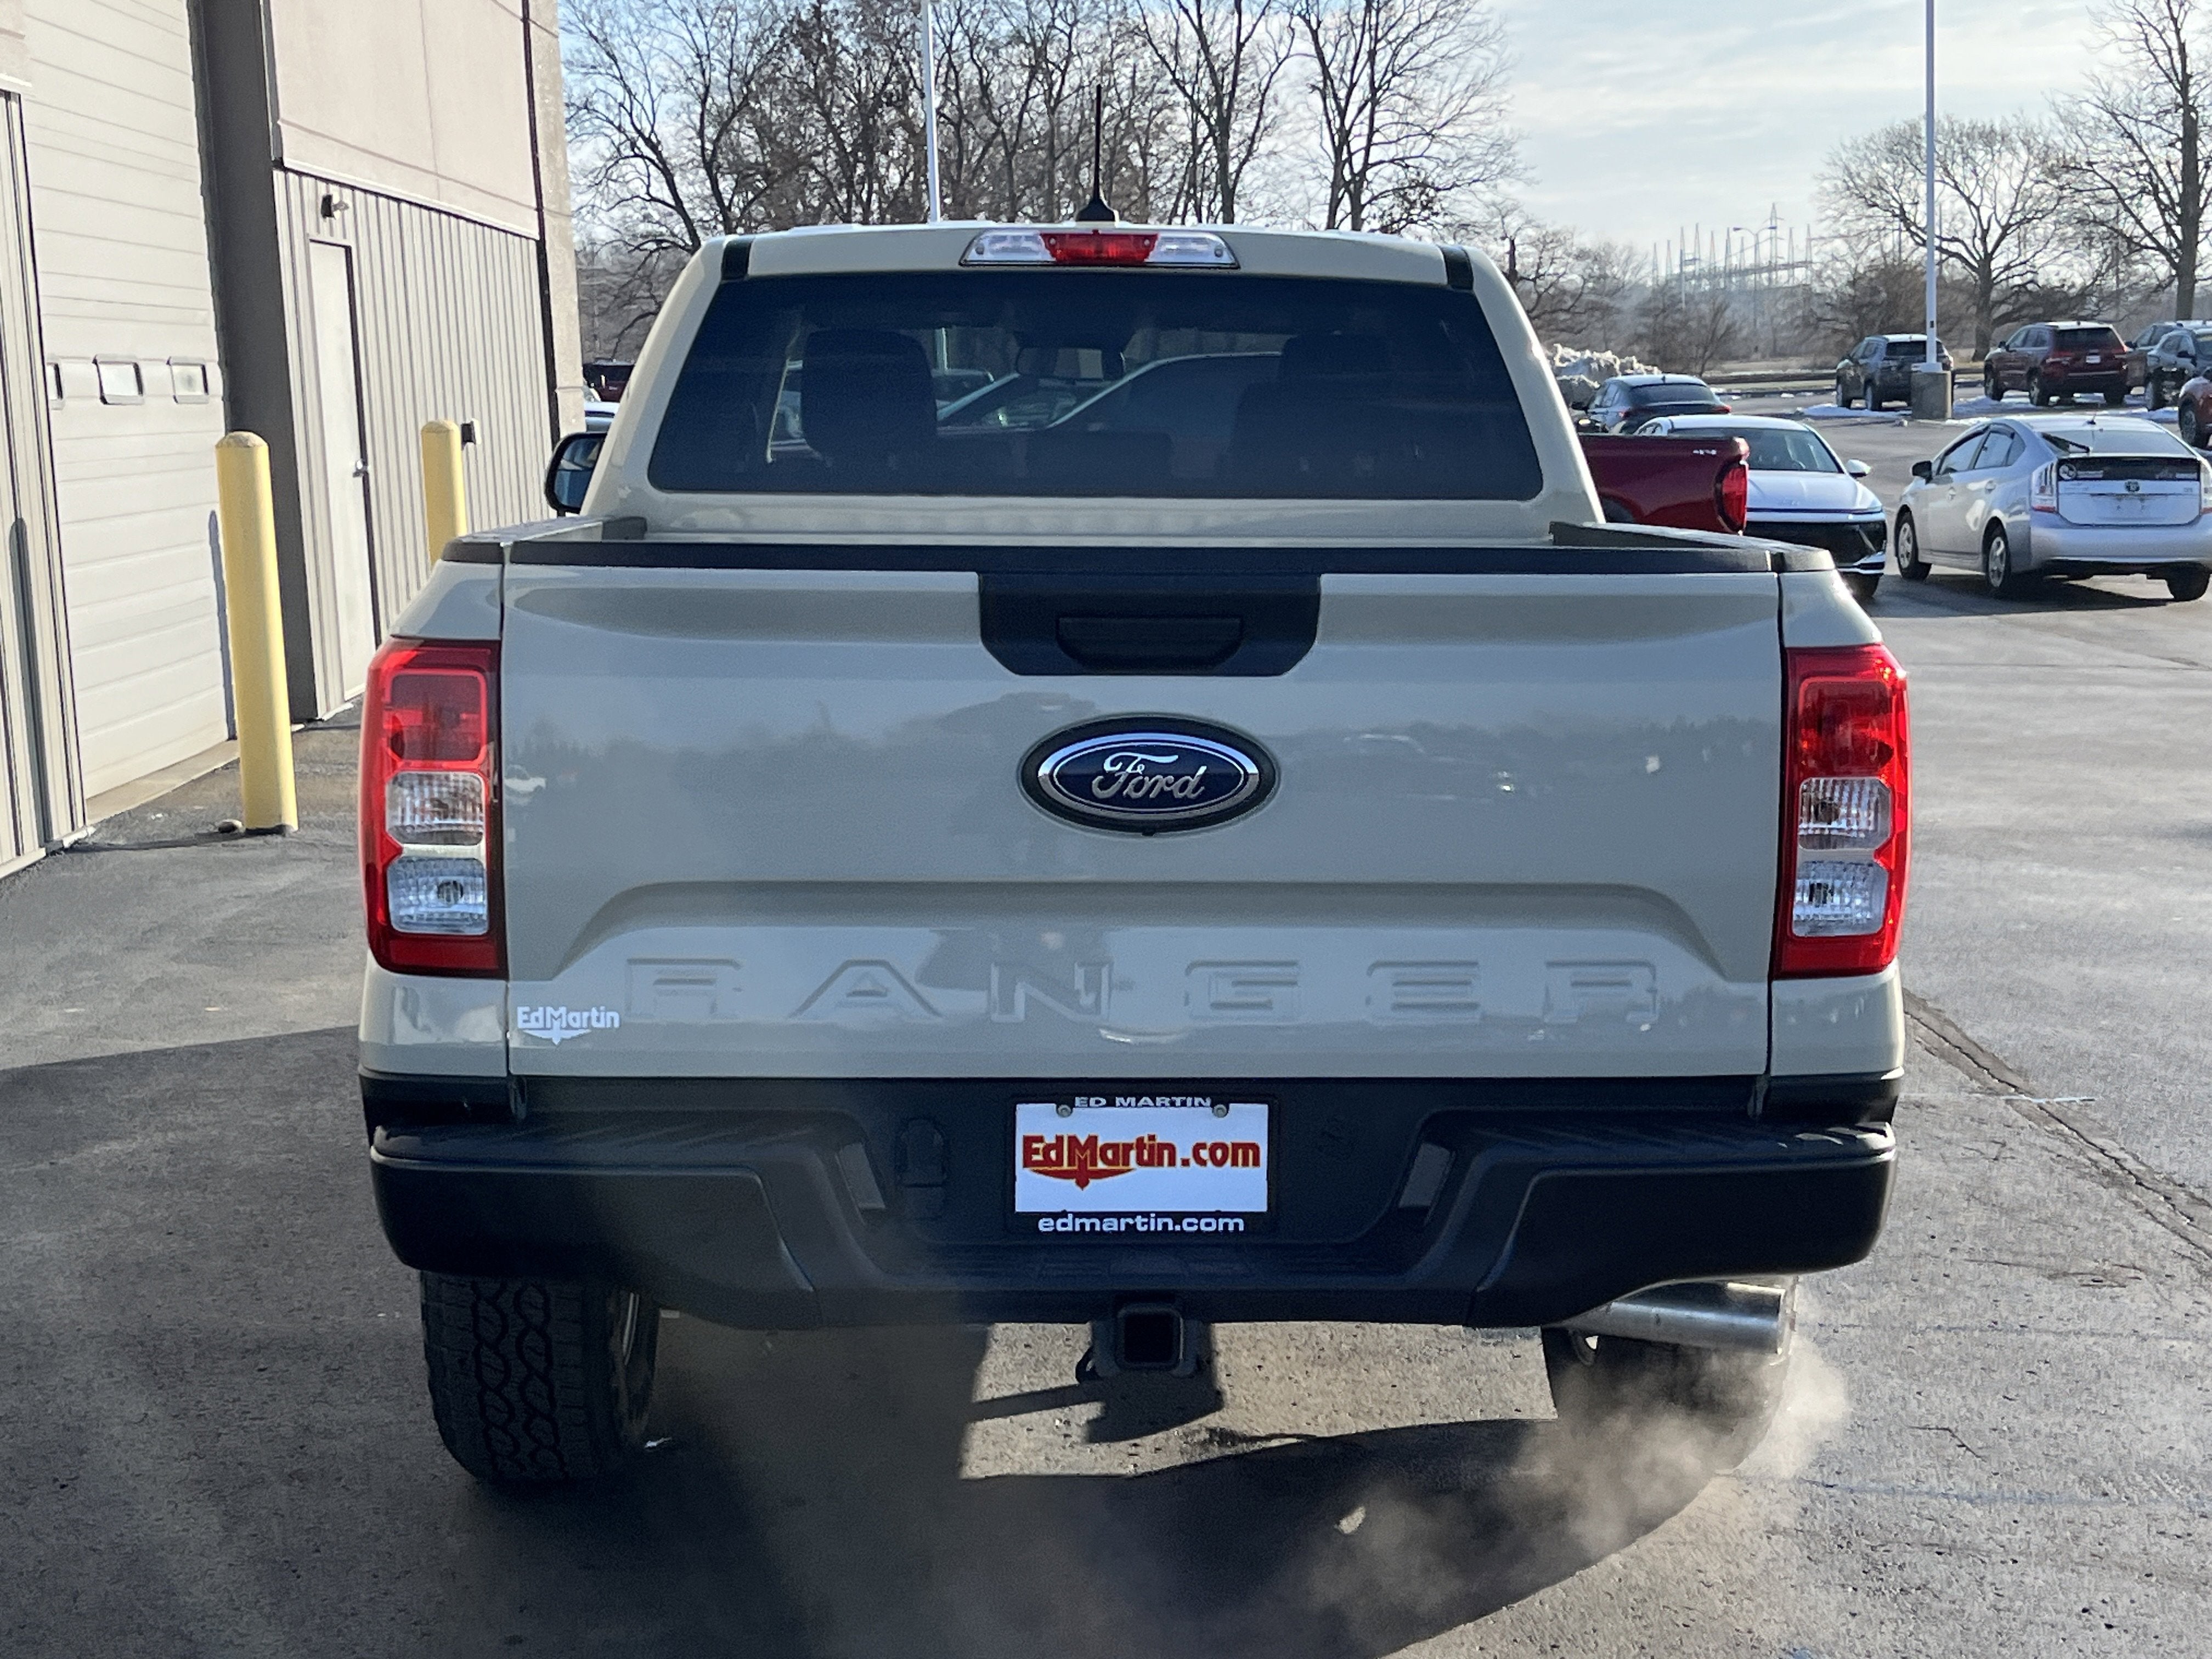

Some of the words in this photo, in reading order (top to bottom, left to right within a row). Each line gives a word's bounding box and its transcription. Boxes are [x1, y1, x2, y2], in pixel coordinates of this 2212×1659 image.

[1092, 752, 1207, 799] Ford
[625, 957, 1658, 1024] RANGER
[517, 1006, 621, 1031] EdMartin
[1074, 1097, 1107, 1107] ED
[1115, 1097, 1212, 1107] MARTIN
[1022, 1133, 1261, 1172] EdMartin.com
[1038, 1214, 1245, 1232] edmartin.com
